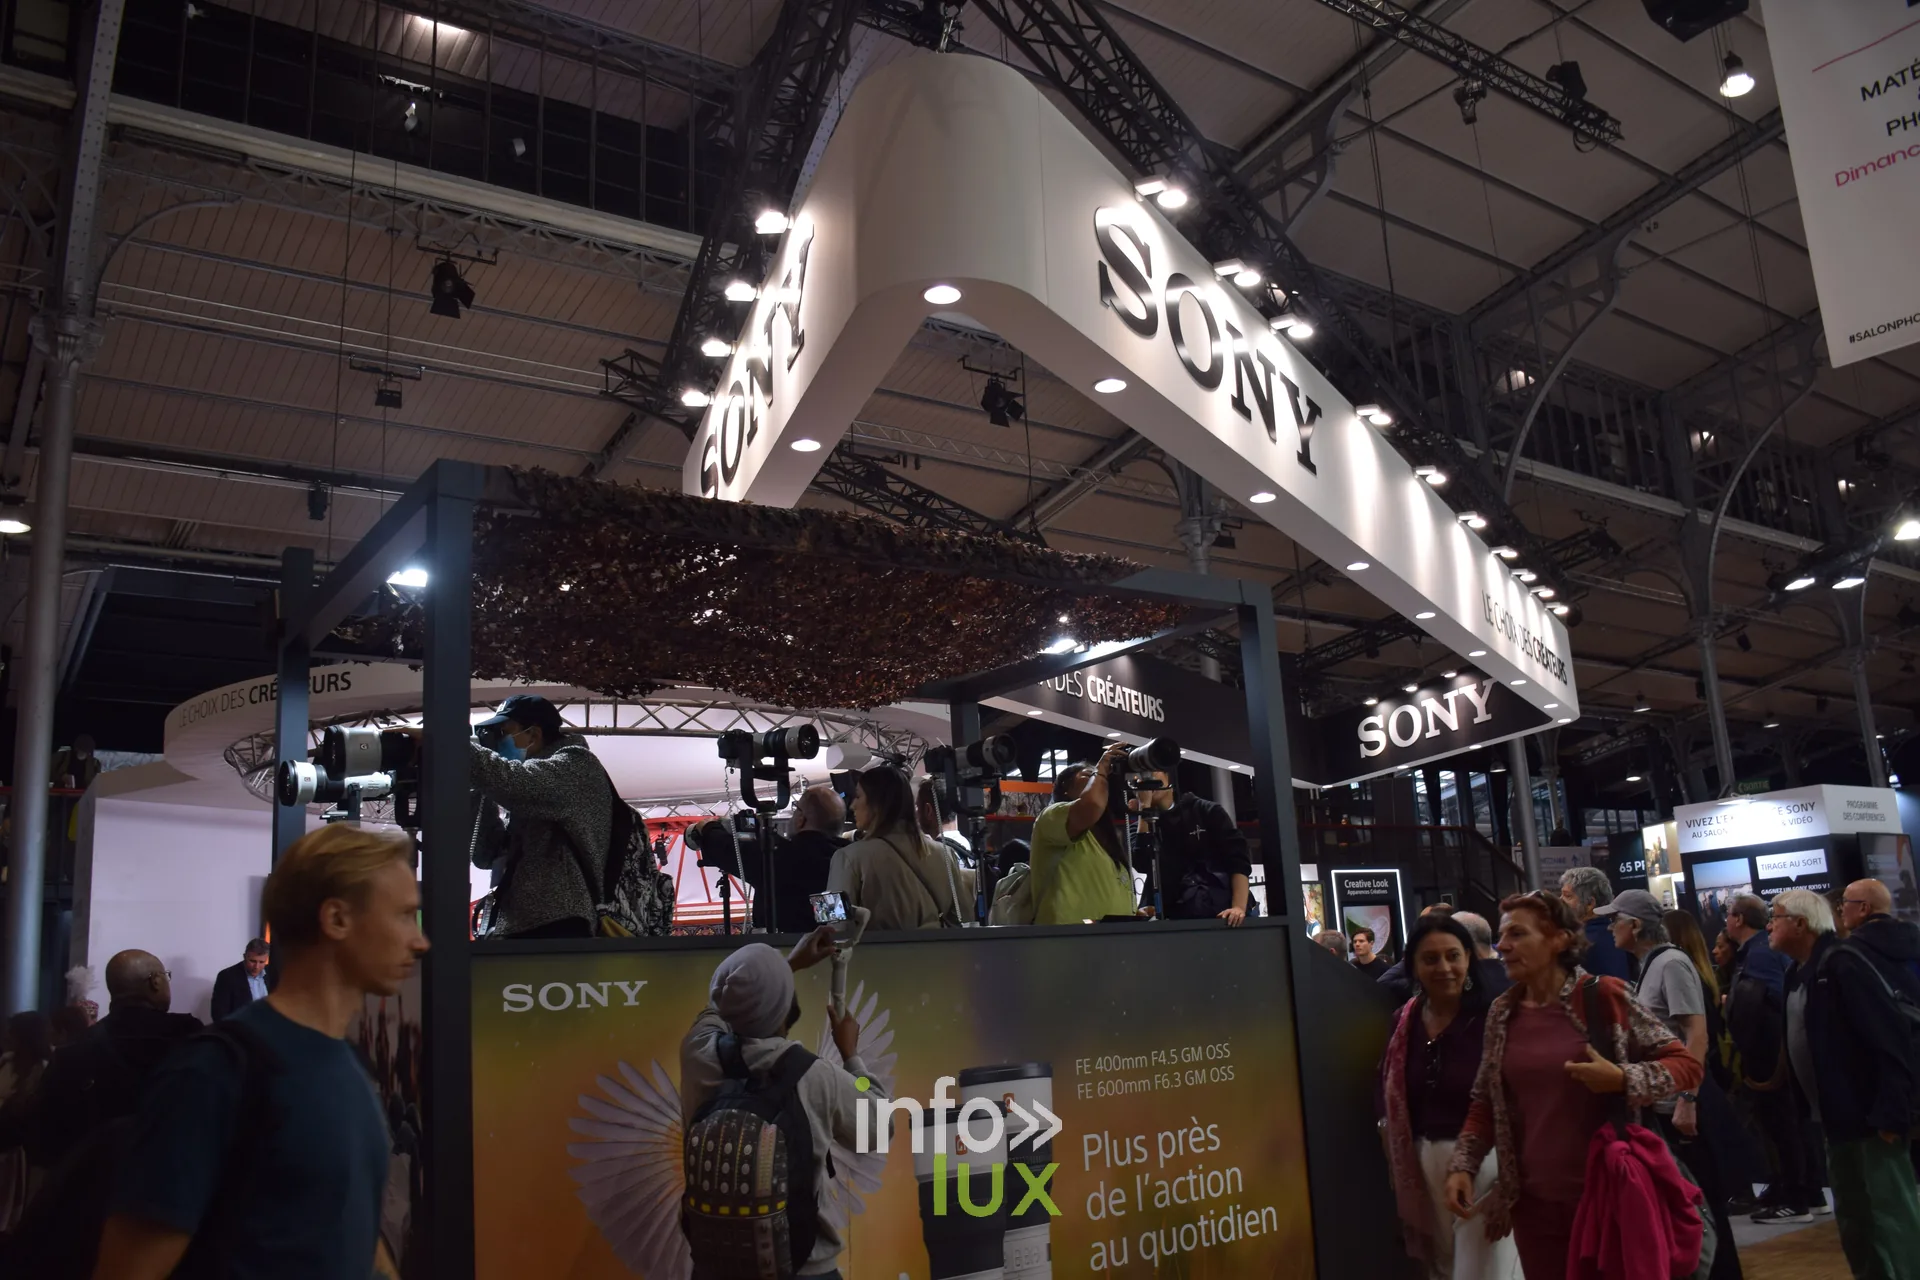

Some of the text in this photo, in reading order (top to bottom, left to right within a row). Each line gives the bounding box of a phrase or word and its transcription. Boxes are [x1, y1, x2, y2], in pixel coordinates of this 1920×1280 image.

[1886, 111, 1920, 136] PH
[1094, 206, 1322, 476] SONY
[1482, 589, 1494, 626] LE
[188, 695, 219, 724] CHOIX
[221, 688, 245, 712] DES
[249, 671, 352, 705] CRÉURS
[1086, 675, 1165, 723] CRÉATEURS
[1357, 677, 1499, 759] SONY
[1685, 816, 1714, 829] VIVEZ
[1786, 801, 1816, 815] SONY
[1843, 812, 1853, 821] DES
[1846, 800, 1879, 809] PROGRAMME
[1691, 831, 1703, 839] AU
[1788, 815, 1813, 827] VIDÉO
[1619, 861, 1632, 873] 65
[1760, 857, 1822, 871] TIRAGE AU SORT
[1344, 878, 1389, 888] Creative Look
[1760, 887, 1783, 895] GAGNEZ
[502, 980, 648, 1013] SONY
[1075, 1043, 1231, 1076] FE 400mm F4.5 GM OSS
[1077, 1065, 1235, 1100] FE 600mm F6.3 GM OSS
[1082, 1116, 1221, 1171] Plus près
[1086, 1164, 1243, 1221] de l'action
[1089, 1204, 1278, 1271] au quotidien
